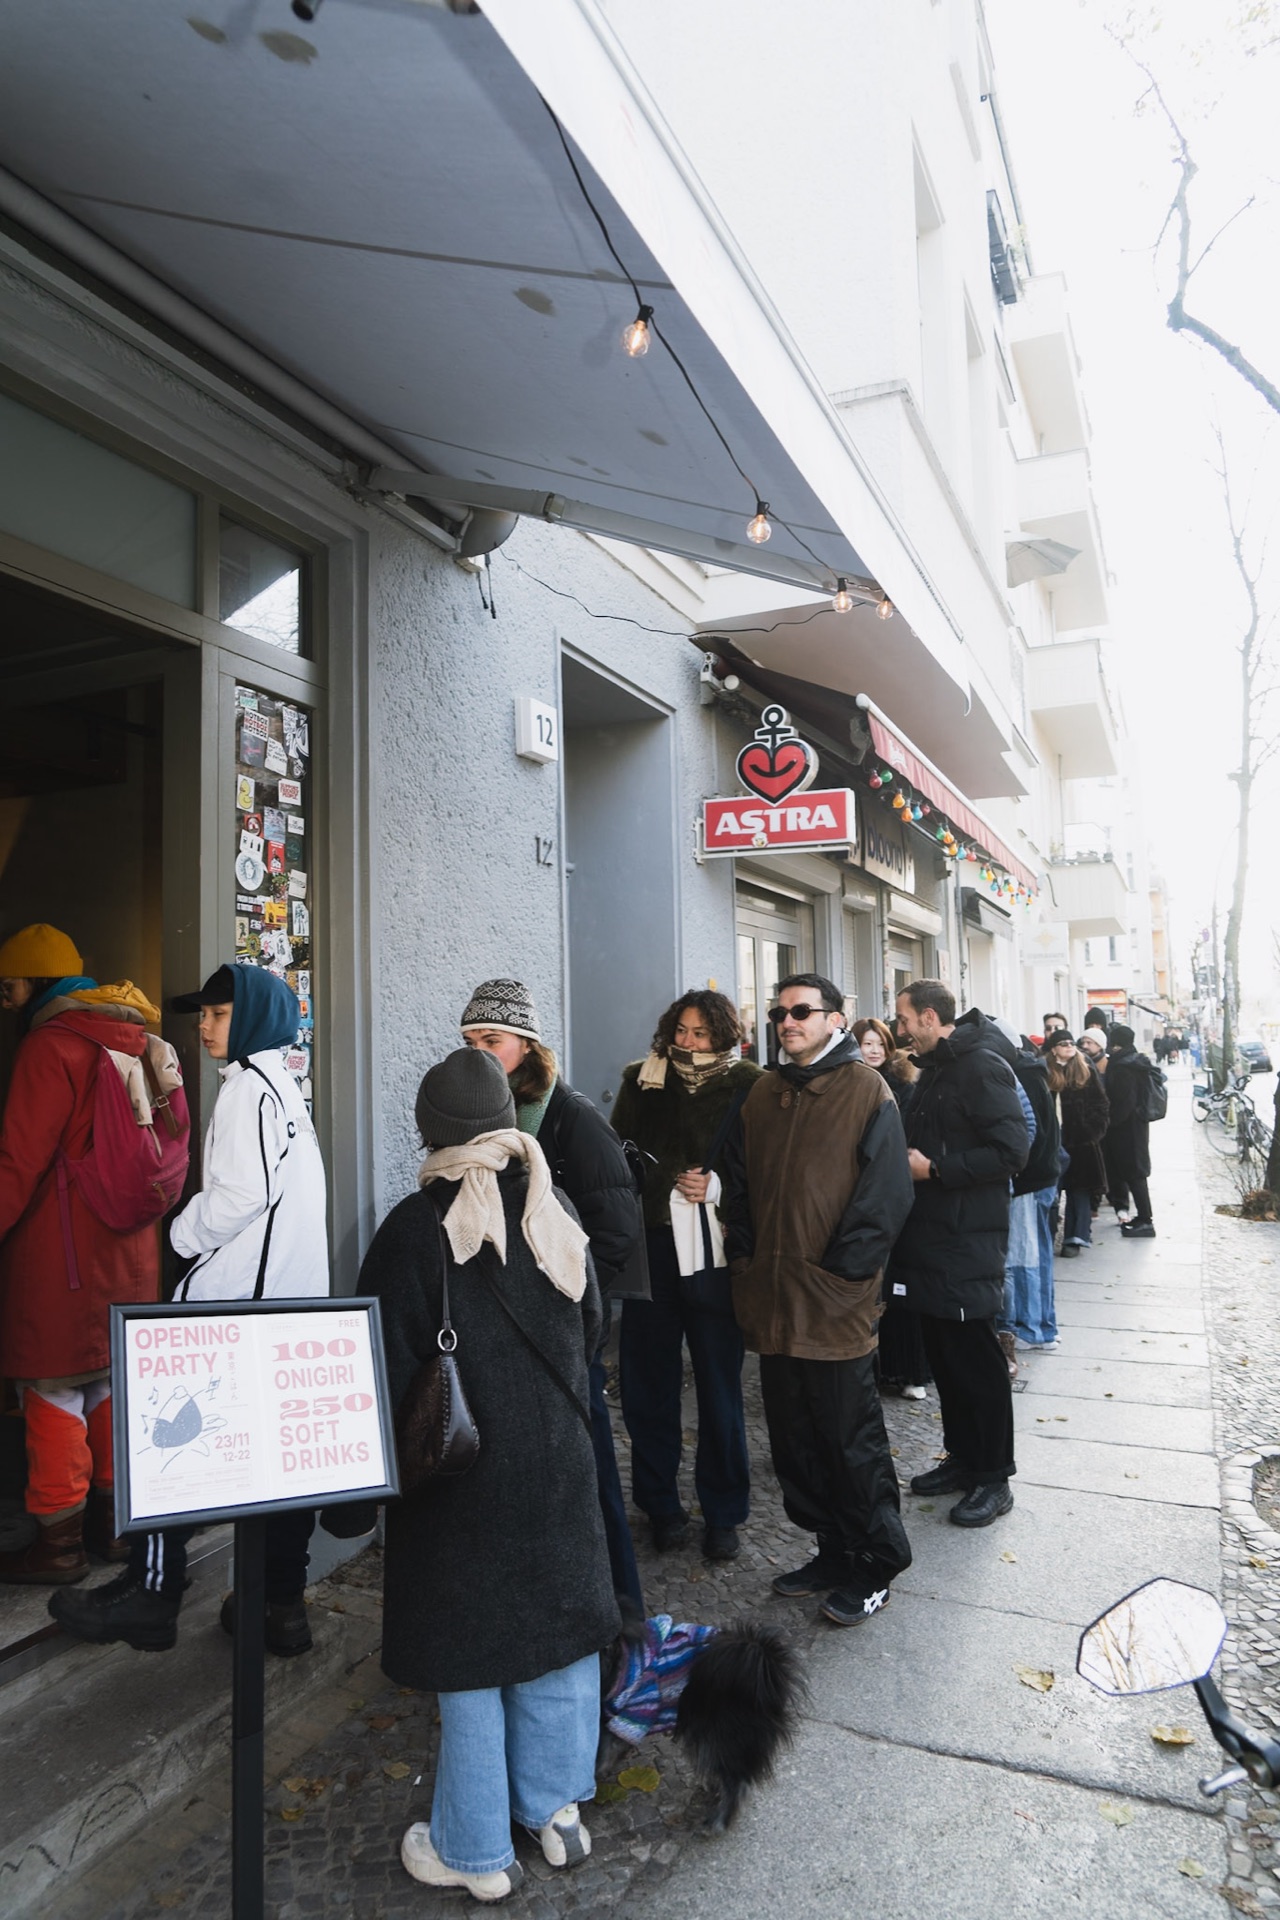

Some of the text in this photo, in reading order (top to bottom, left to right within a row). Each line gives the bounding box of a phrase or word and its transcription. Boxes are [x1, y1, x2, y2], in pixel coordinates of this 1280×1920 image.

[536, 714, 553, 746] 12
[715, 804, 837, 836] ASTRA
[535, 835, 553, 867] 12
[135, 1323, 240, 1350] OPENING
[338, 1318, 360, 1328] FREE
[272, 1338, 357, 1362] 100
[138, 1351, 218, 1379] PARTY
[274, 1364, 354, 1390] ONIGIRI
[280, 1392, 373, 1420] 250
[215, 1432, 250, 1449] 23/11
[280, 1419, 340, 1447] SOFT
[223, 1449, 251, 1462] 12-22
[281, 1441, 370, 1473] DRINKS
